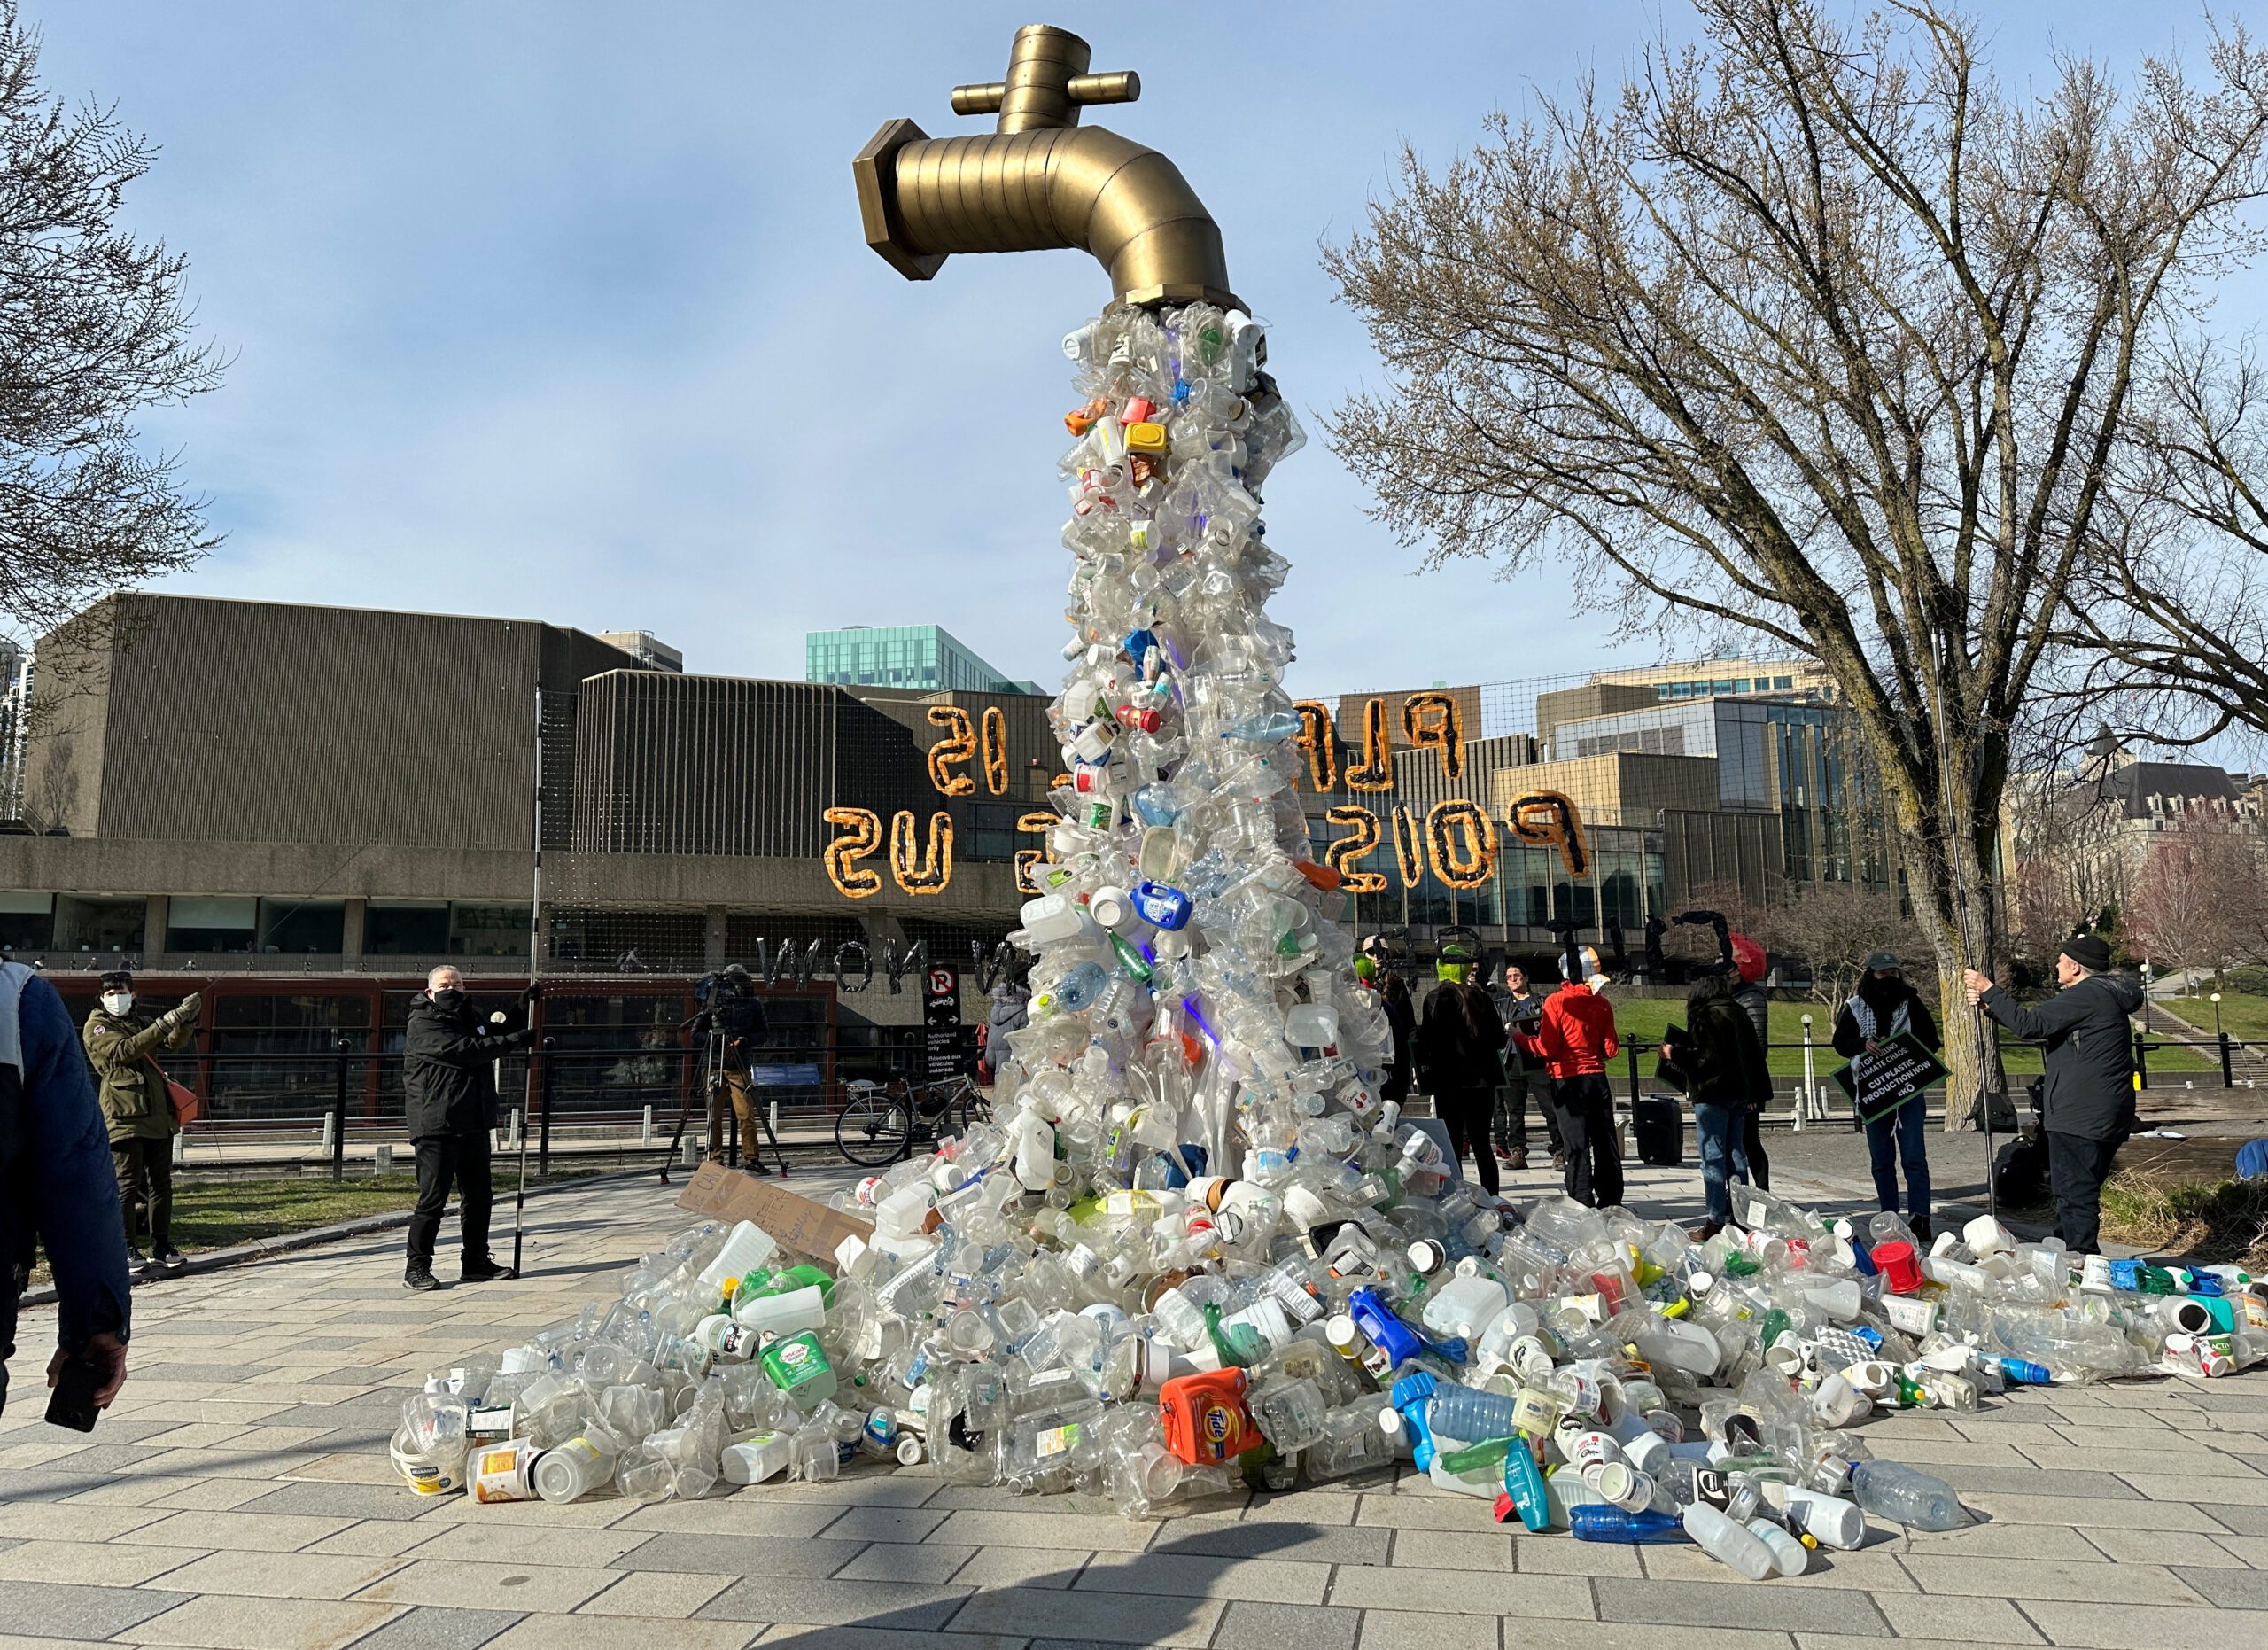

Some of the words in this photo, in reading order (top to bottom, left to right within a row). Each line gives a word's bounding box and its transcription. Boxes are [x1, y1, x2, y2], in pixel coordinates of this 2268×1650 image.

[1858, 1059, 1886, 1080] CLIMATE
[1862, 1071, 1915, 1104] PRODUCTION
[1914, 1060, 1931, 1075] NOW
[1868, 1075, 1886, 1089] CUT
[1884, 1058, 1915, 1079] PLASTIC
[779, 1344, 809, 1363] Cascade
[1207, 1409, 1226, 1439] Tide
